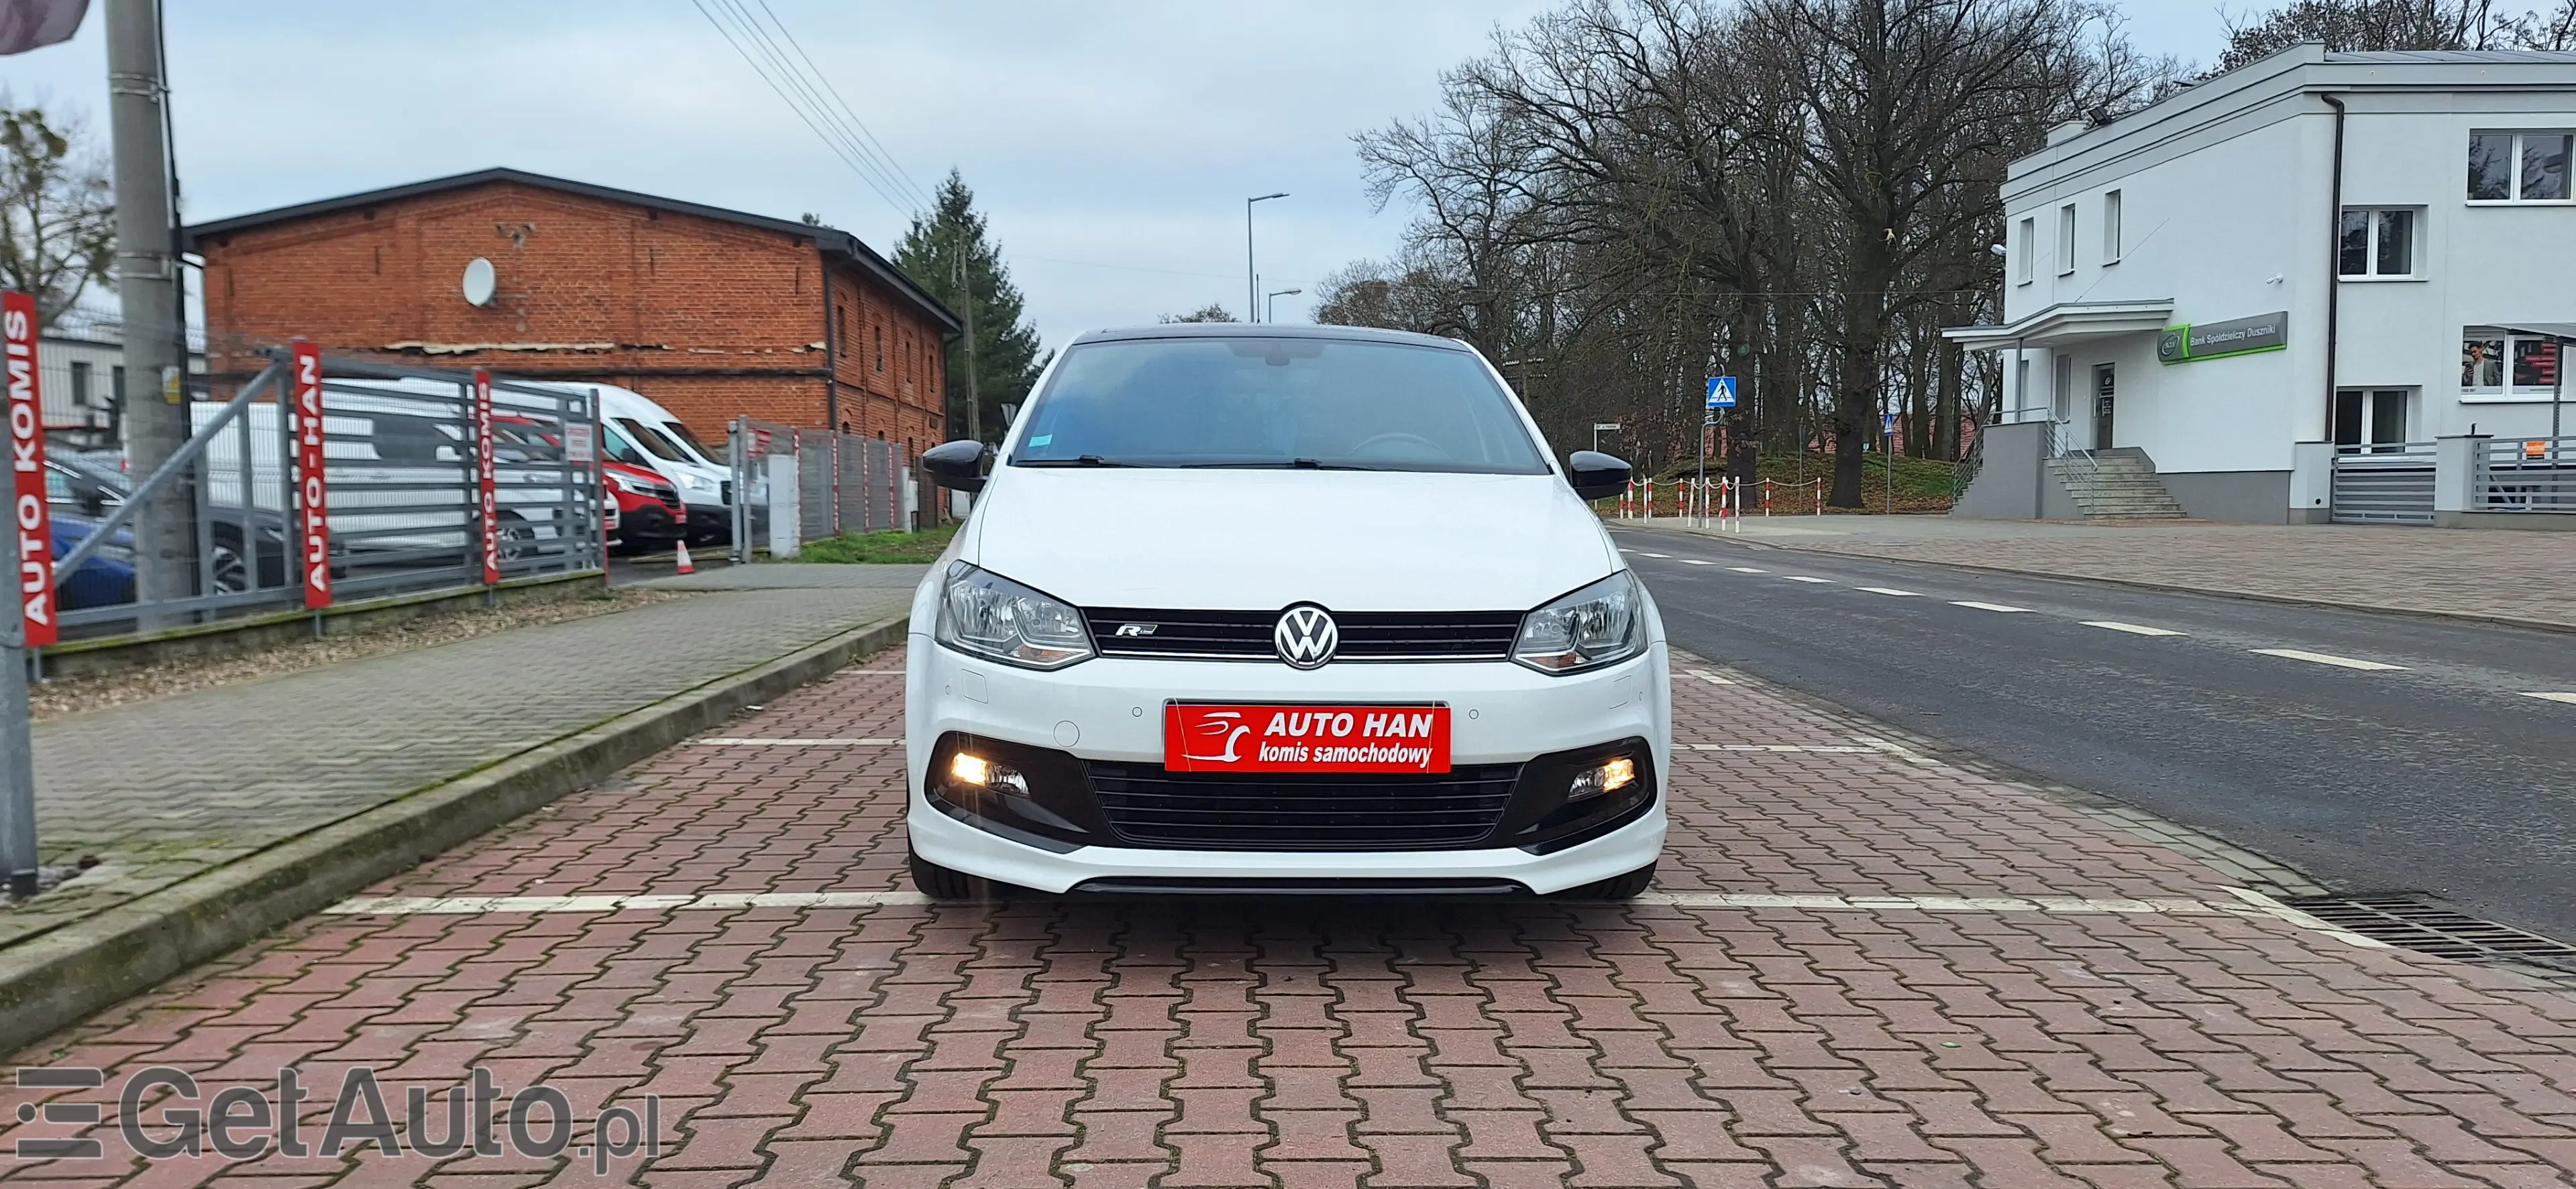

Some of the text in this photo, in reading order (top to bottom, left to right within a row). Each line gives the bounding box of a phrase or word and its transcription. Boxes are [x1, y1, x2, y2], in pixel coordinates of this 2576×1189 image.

[2190, 336, 2206, 347] Bank
[2247, 324, 2275, 337] Duszniki
[300, 355, 320, 445] HAN
[5, 310, 49, 626] AUTO KOMIS
[478, 382, 499, 571] AUTO KOMIS
[306, 476, 325, 592] AUTO
[1258, 741, 1433, 769] komis samochodowy
[1264, 712, 1434, 738] AUTO HAN
